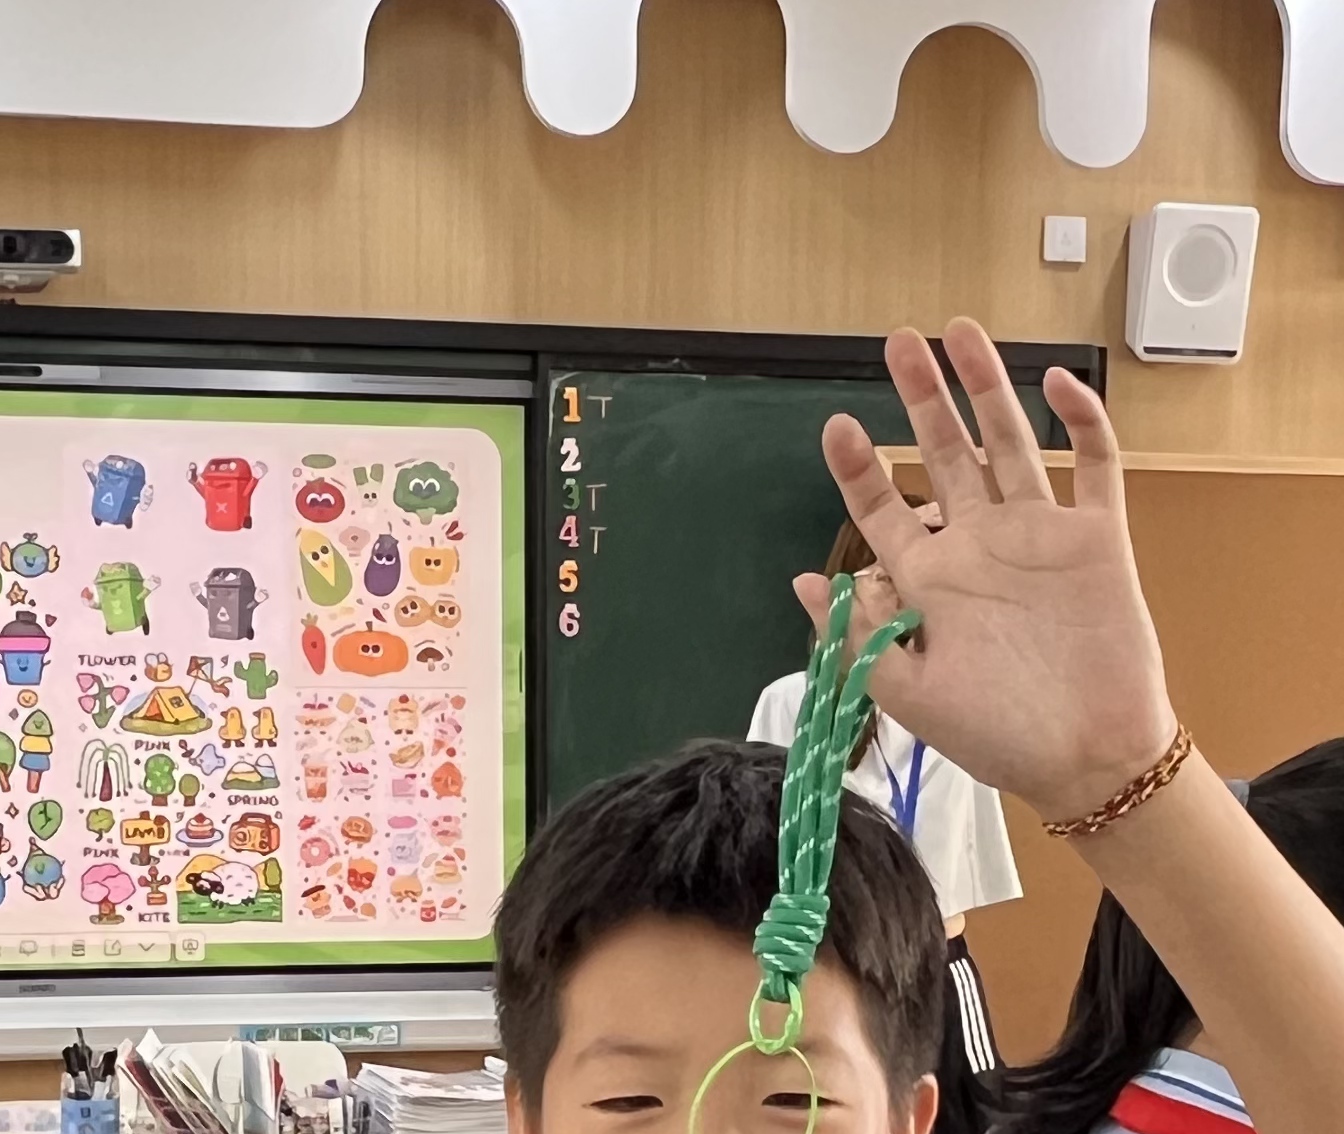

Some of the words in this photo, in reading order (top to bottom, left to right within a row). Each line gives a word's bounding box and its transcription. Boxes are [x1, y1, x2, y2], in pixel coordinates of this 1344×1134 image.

[563, 386, 581, 422] 1
[560, 437, 582, 472] 2
[562, 478, 580, 511] 3
[558, 515, 580, 548] 4
[558, 559, 579, 593] 5
[558, 602, 581, 637] 6
